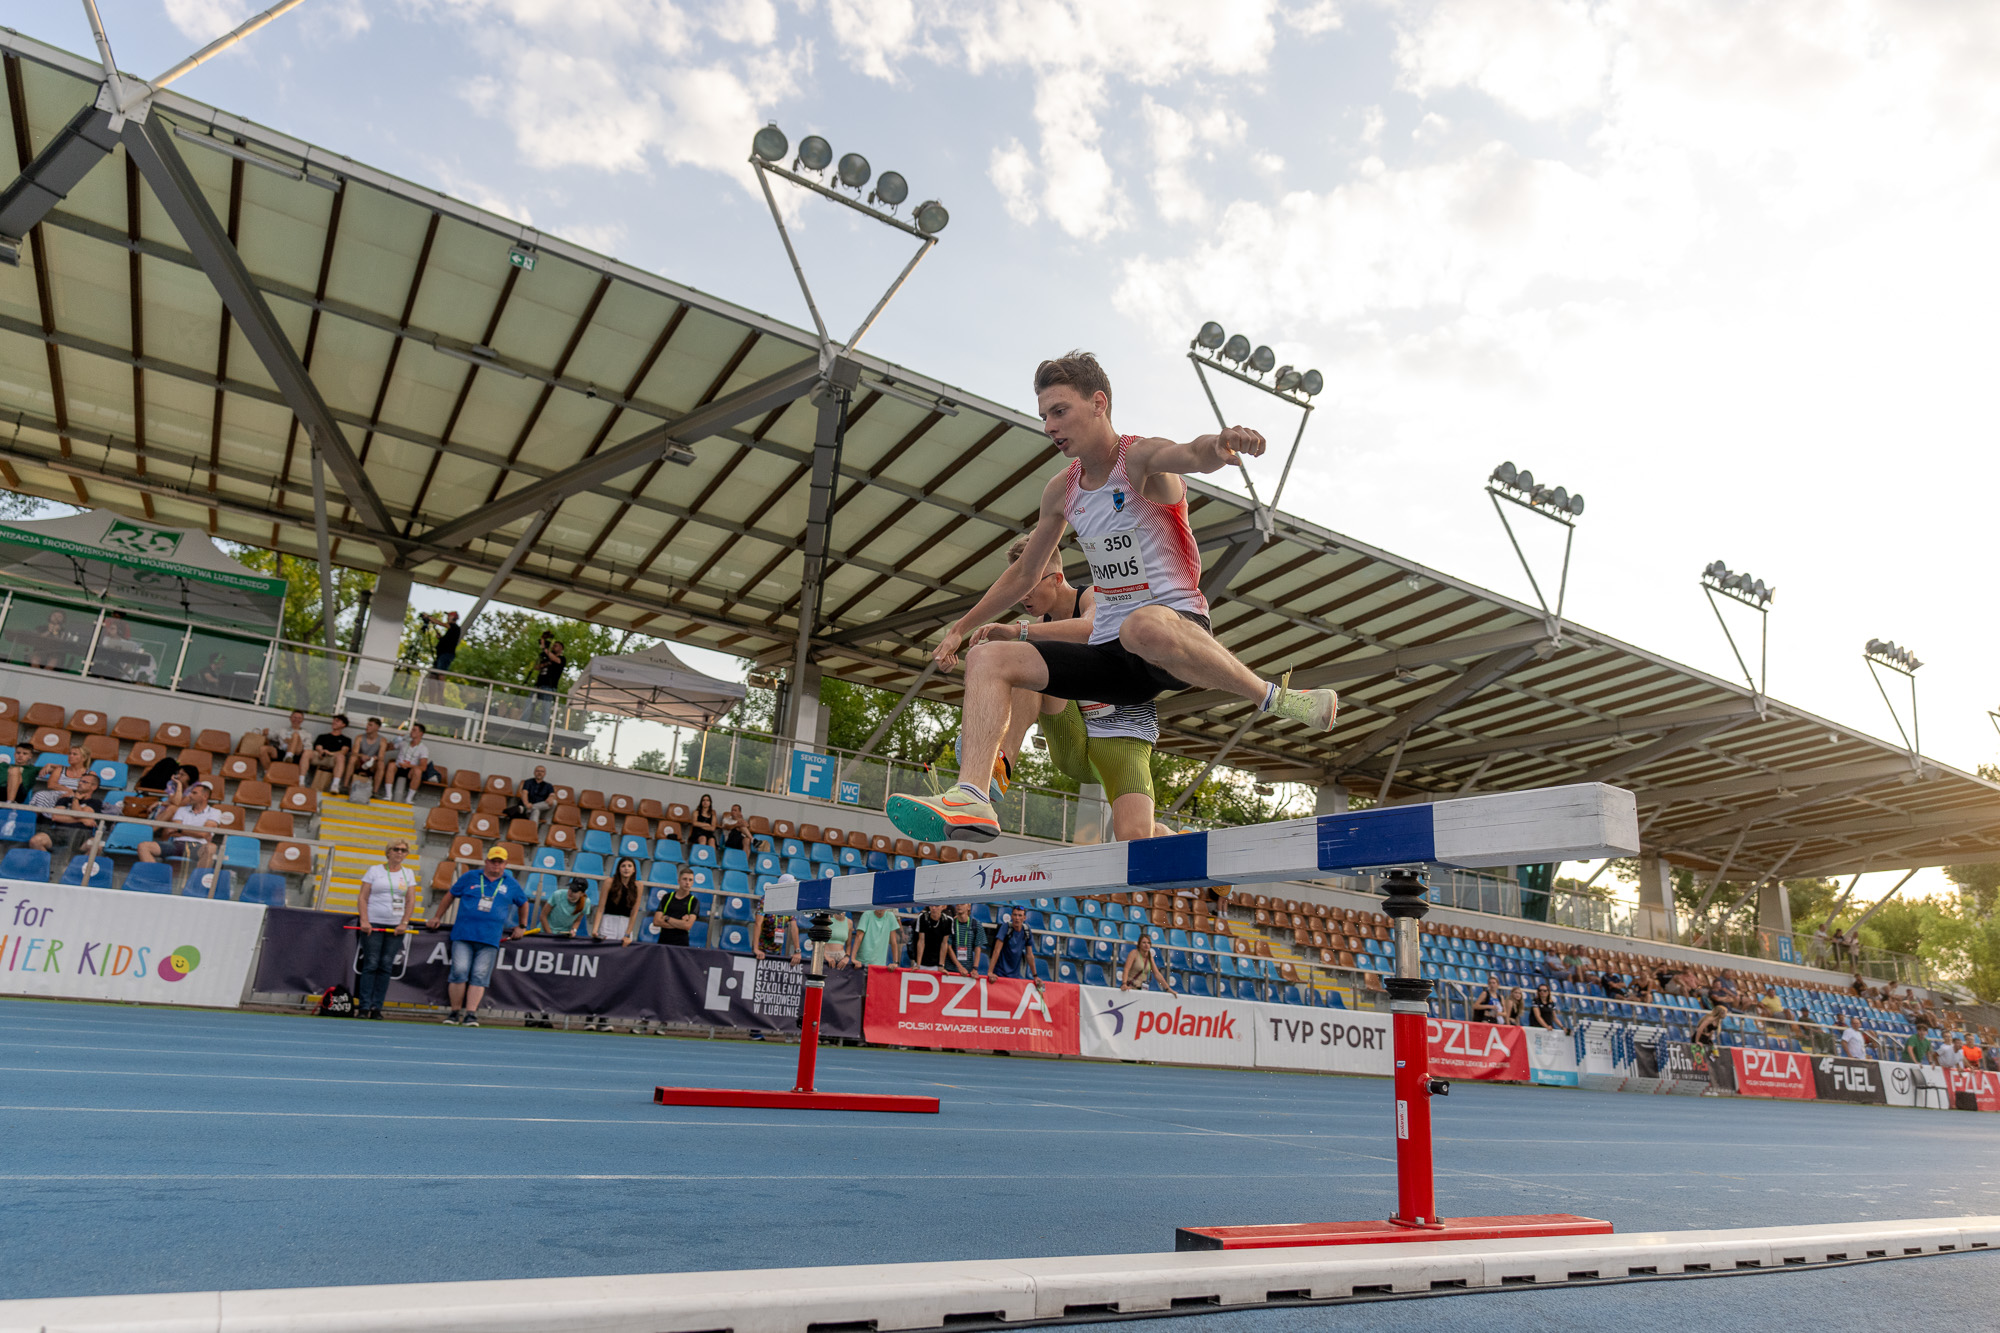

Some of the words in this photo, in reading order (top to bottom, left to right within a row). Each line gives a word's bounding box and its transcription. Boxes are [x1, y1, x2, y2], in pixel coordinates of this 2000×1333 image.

[1103, 534, 1132, 552] 350
[800, 753, 827, 765] SEKTOR
[802, 763, 822, 792] F
[842, 784, 858, 796] WC
[13, 899, 54, 927] for
[77, 942, 151, 978] KIDS
[496, 947, 600, 978] LUBLIN
[755, 981, 802, 996] SZKOLENIA
[756, 970, 803, 985] CENTRUM
[753, 1003, 761, 1014] W
[763, 1004, 799, 1018] LUBLINIE
[754, 992, 801, 1007] SPORTOWEGO
[898, 972, 1053, 1023] PZLA
[898, 1021, 933, 1031] POLSKI
[935, 1023, 978, 1034] ZWIĄZEK
[979, 1025, 1016, 1035] LEKKIEJ
[1017, 1027, 1053, 1037] ATLETYKI
[1134, 1005, 1237, 1041] polanik
[1269, 1017, 1314, 1044] TVP
[1320, 1022, 1386, 1050] SPORT
[1427, 1019, 1511, 1058] PZLA
[1742, 1050, 1802, 1080] PZLA
[1833, 1065, 1876, 1093] FUEL
[1950, 1070, 1994, 1095] PZLA
